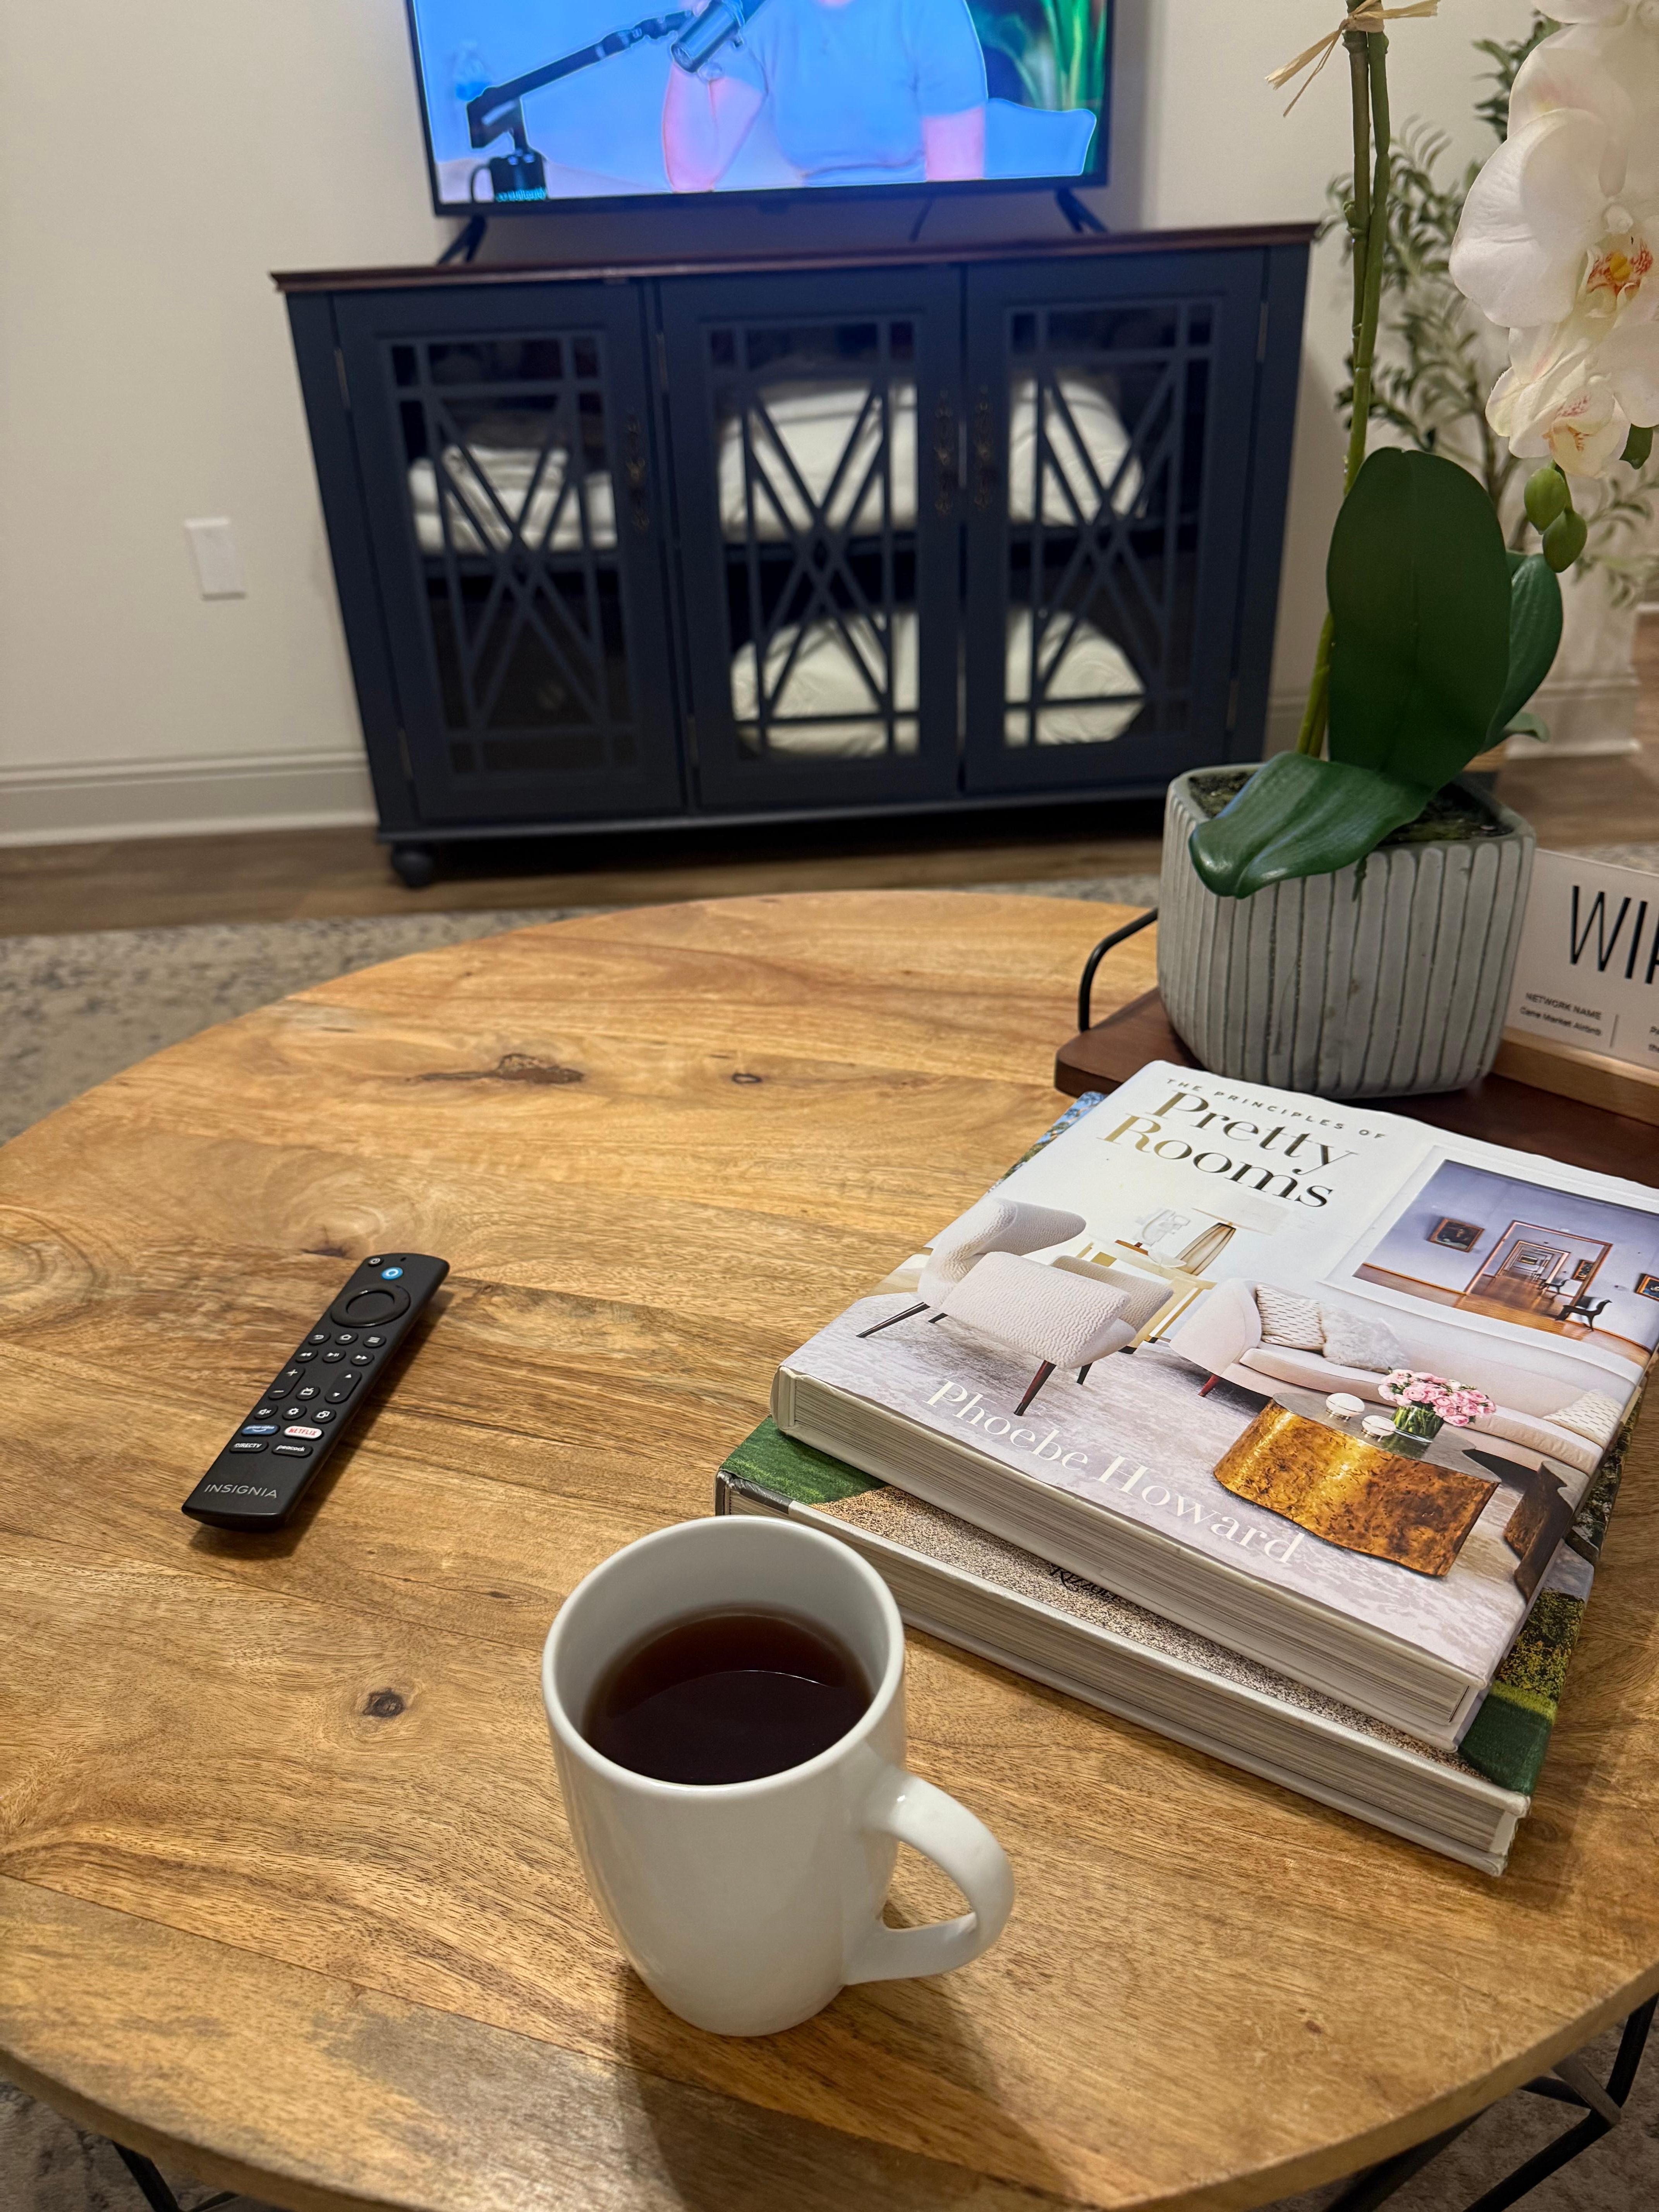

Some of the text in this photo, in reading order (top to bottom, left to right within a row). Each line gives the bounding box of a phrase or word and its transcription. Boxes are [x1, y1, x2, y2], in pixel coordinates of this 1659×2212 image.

[1526, 993, 1602, 1020] NETWORK NAME
[1145, 1090, 1358, 1175] Pretty
[1166, 1078, 1387, 1139] THE PRINCIPLES OF
[1096, 1113, 1334, 1207] Rooms
[204, 1484, 277, 1498] INSIGNIA
[922, 1379, 1305, 1565] Phoebe Howard
